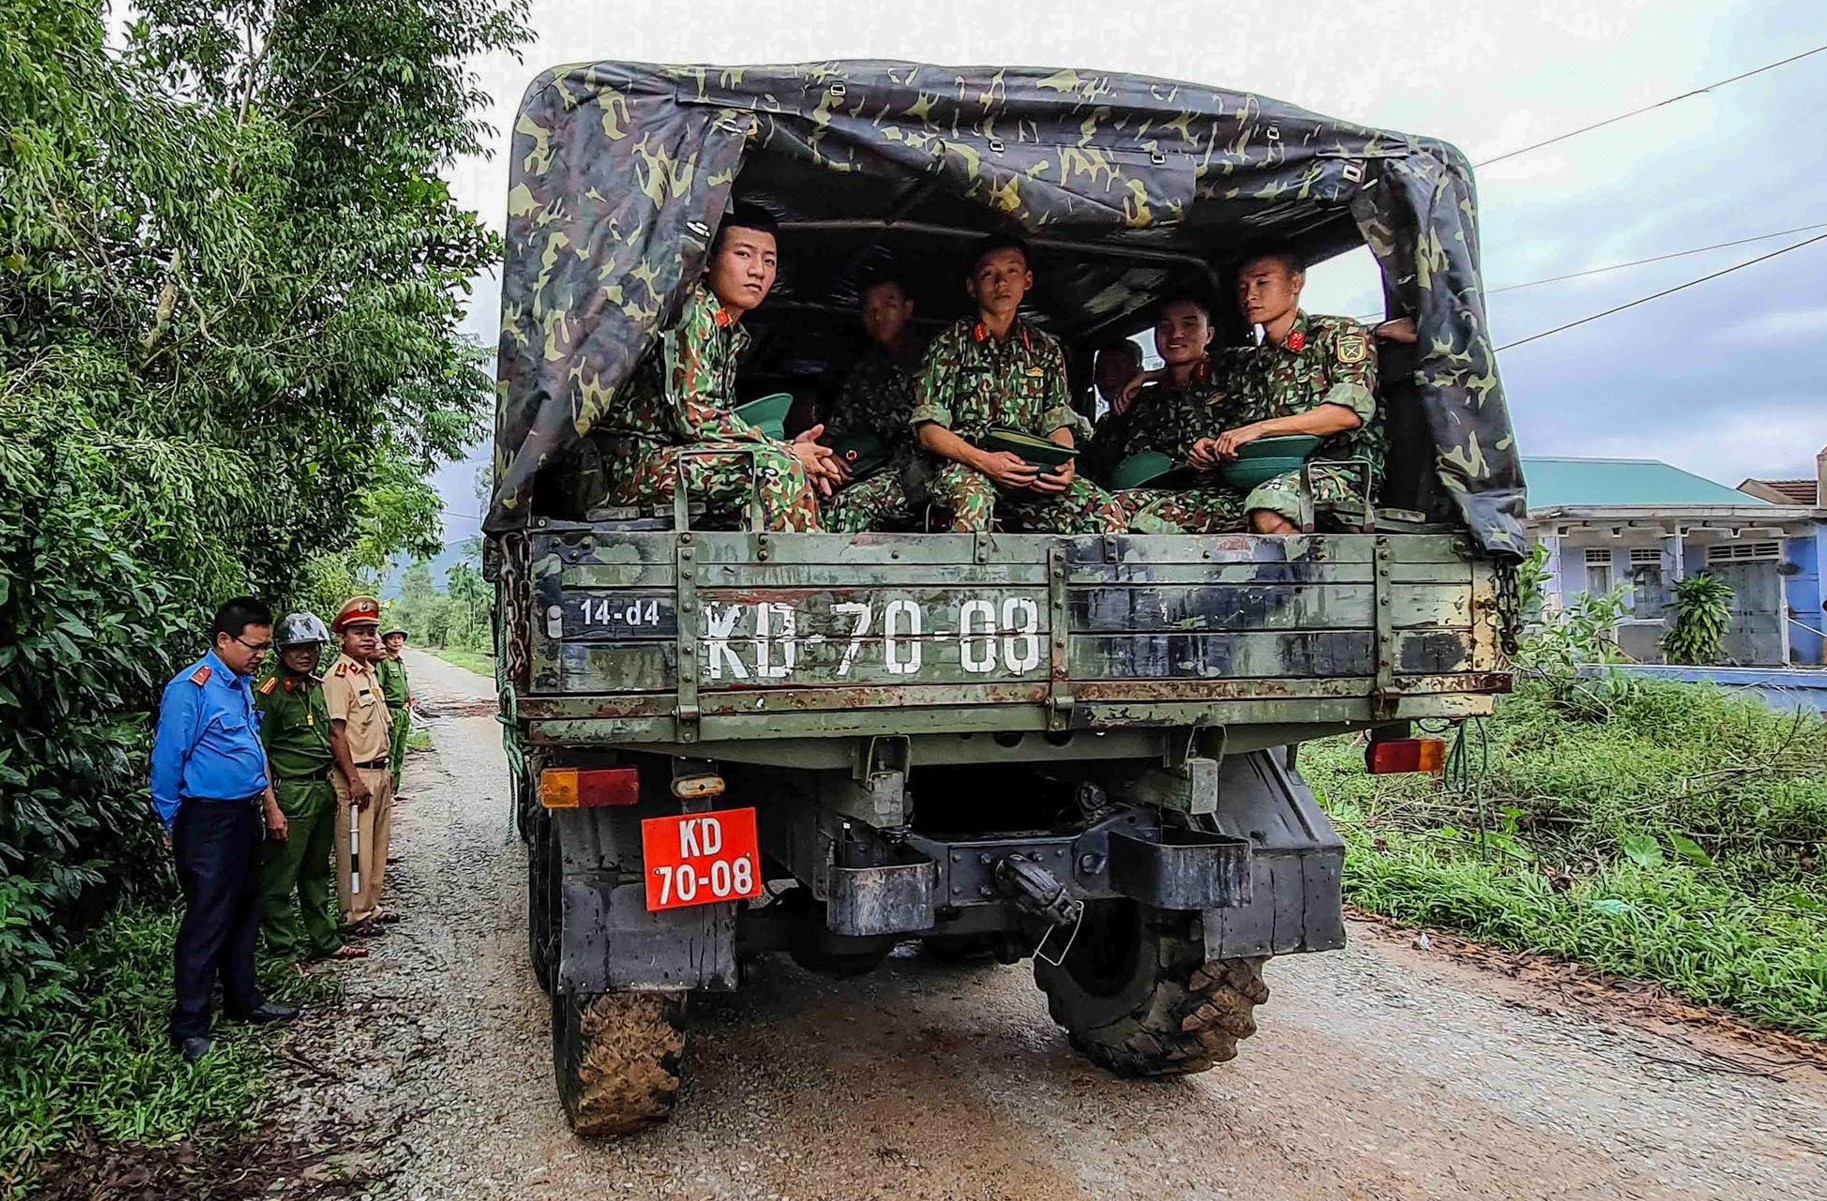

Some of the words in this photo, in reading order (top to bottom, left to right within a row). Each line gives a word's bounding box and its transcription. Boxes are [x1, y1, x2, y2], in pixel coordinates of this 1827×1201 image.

[580, 598, 660, 626] 14-d4
[679, 817, 722, 858] KD
[653, 857, 753, 905] 70-08
